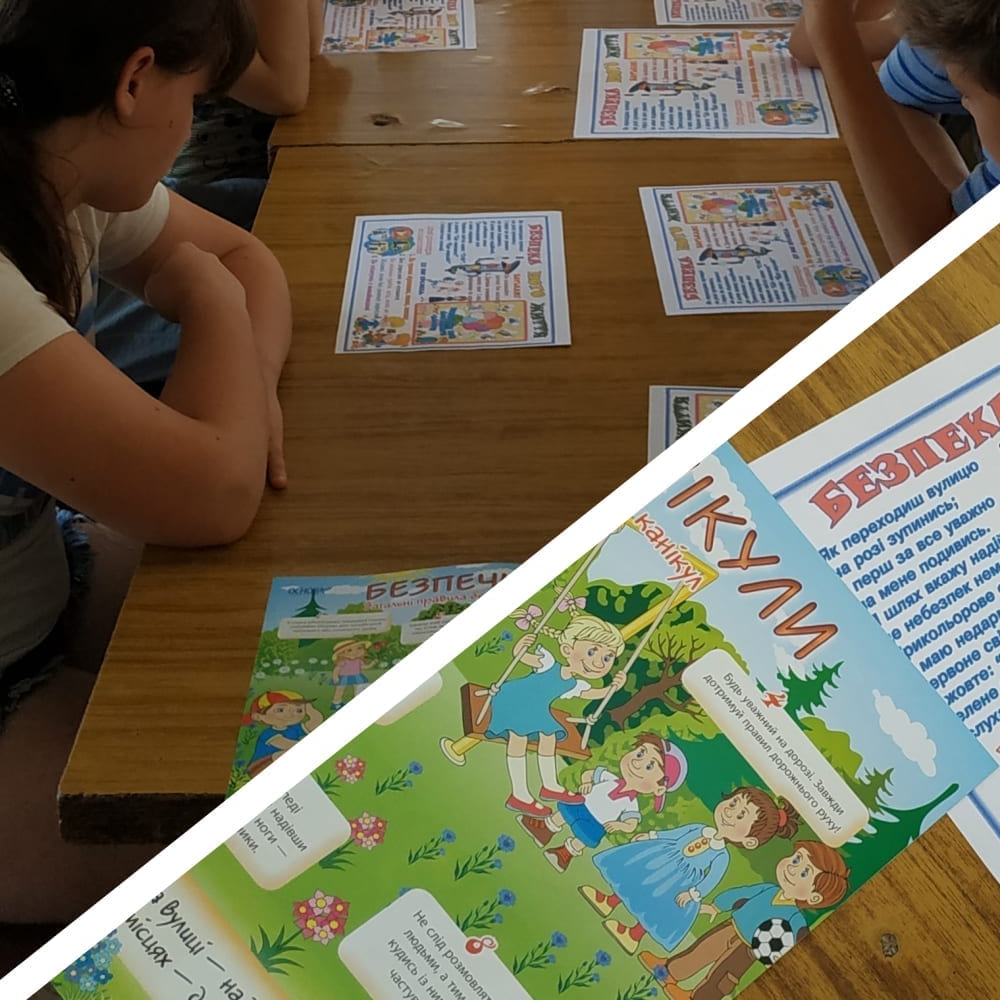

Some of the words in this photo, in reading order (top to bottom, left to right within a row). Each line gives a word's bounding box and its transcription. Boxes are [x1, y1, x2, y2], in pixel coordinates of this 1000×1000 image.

[817, 542, 841, 563] Як
[840, 493, 925, 551] переходиш
[925, 461, 979, 500] вулицю
[853, 537, 886, 571] розі
[886, 496, 959, 546] зупинись;
[633, 511, 705, 592] канікул
[666, 464, 840, 660] ІКУЛИ
[851, 559, 895, 592] перш
[895, 547, 915, 565] за
[915, 529, 943, 553] все
[943, 497, 996, 537] уважно
[877, 569, 917, 601] мене
[918, 527, 991, 574] подивись.
[364, 570, 508, 601] БЕЗПЕЧ
[883, 589, 924, 622] шлях
[924, 559, 968, 595] вкажу
[903, 581, 973, 633] небезпек
[899, 588, 1000, 661] рикольорове
[919, 644, 953, 673] маю
[927, 647, 985, 692] ервоне
[943, 664, 995, 707] жовте:
[955, 686, 1000, 722] елене
[702, 674, 745, 720] дотримуй
[742, 718, 772, 753] правил
[768, 752, 819, 808] дорожнього
[815, 807, 842, 834] руху!
[723, 672, 743, 696] Будь
[739, 695, 778, 736] уважний
[775, 735, 788, 749] на
[783, 748, 816, 782] дорозі.
[813, 778, 845, 816] Завжди
[237, 827, 259, 854] ики.
[254, 817, 278, 845] ноги
[270, 808, 308, 852] надівши
[155, 899, 213, 956] вулиці
[412, 909, 429, 928] Не
[426, 927, 447, 952] слід
[387, 938, 418, 976] кудись
[417, 975, 429, 987] із
[403, 929, 441, 975] людьми,
[439, 972, 449, 982] а
